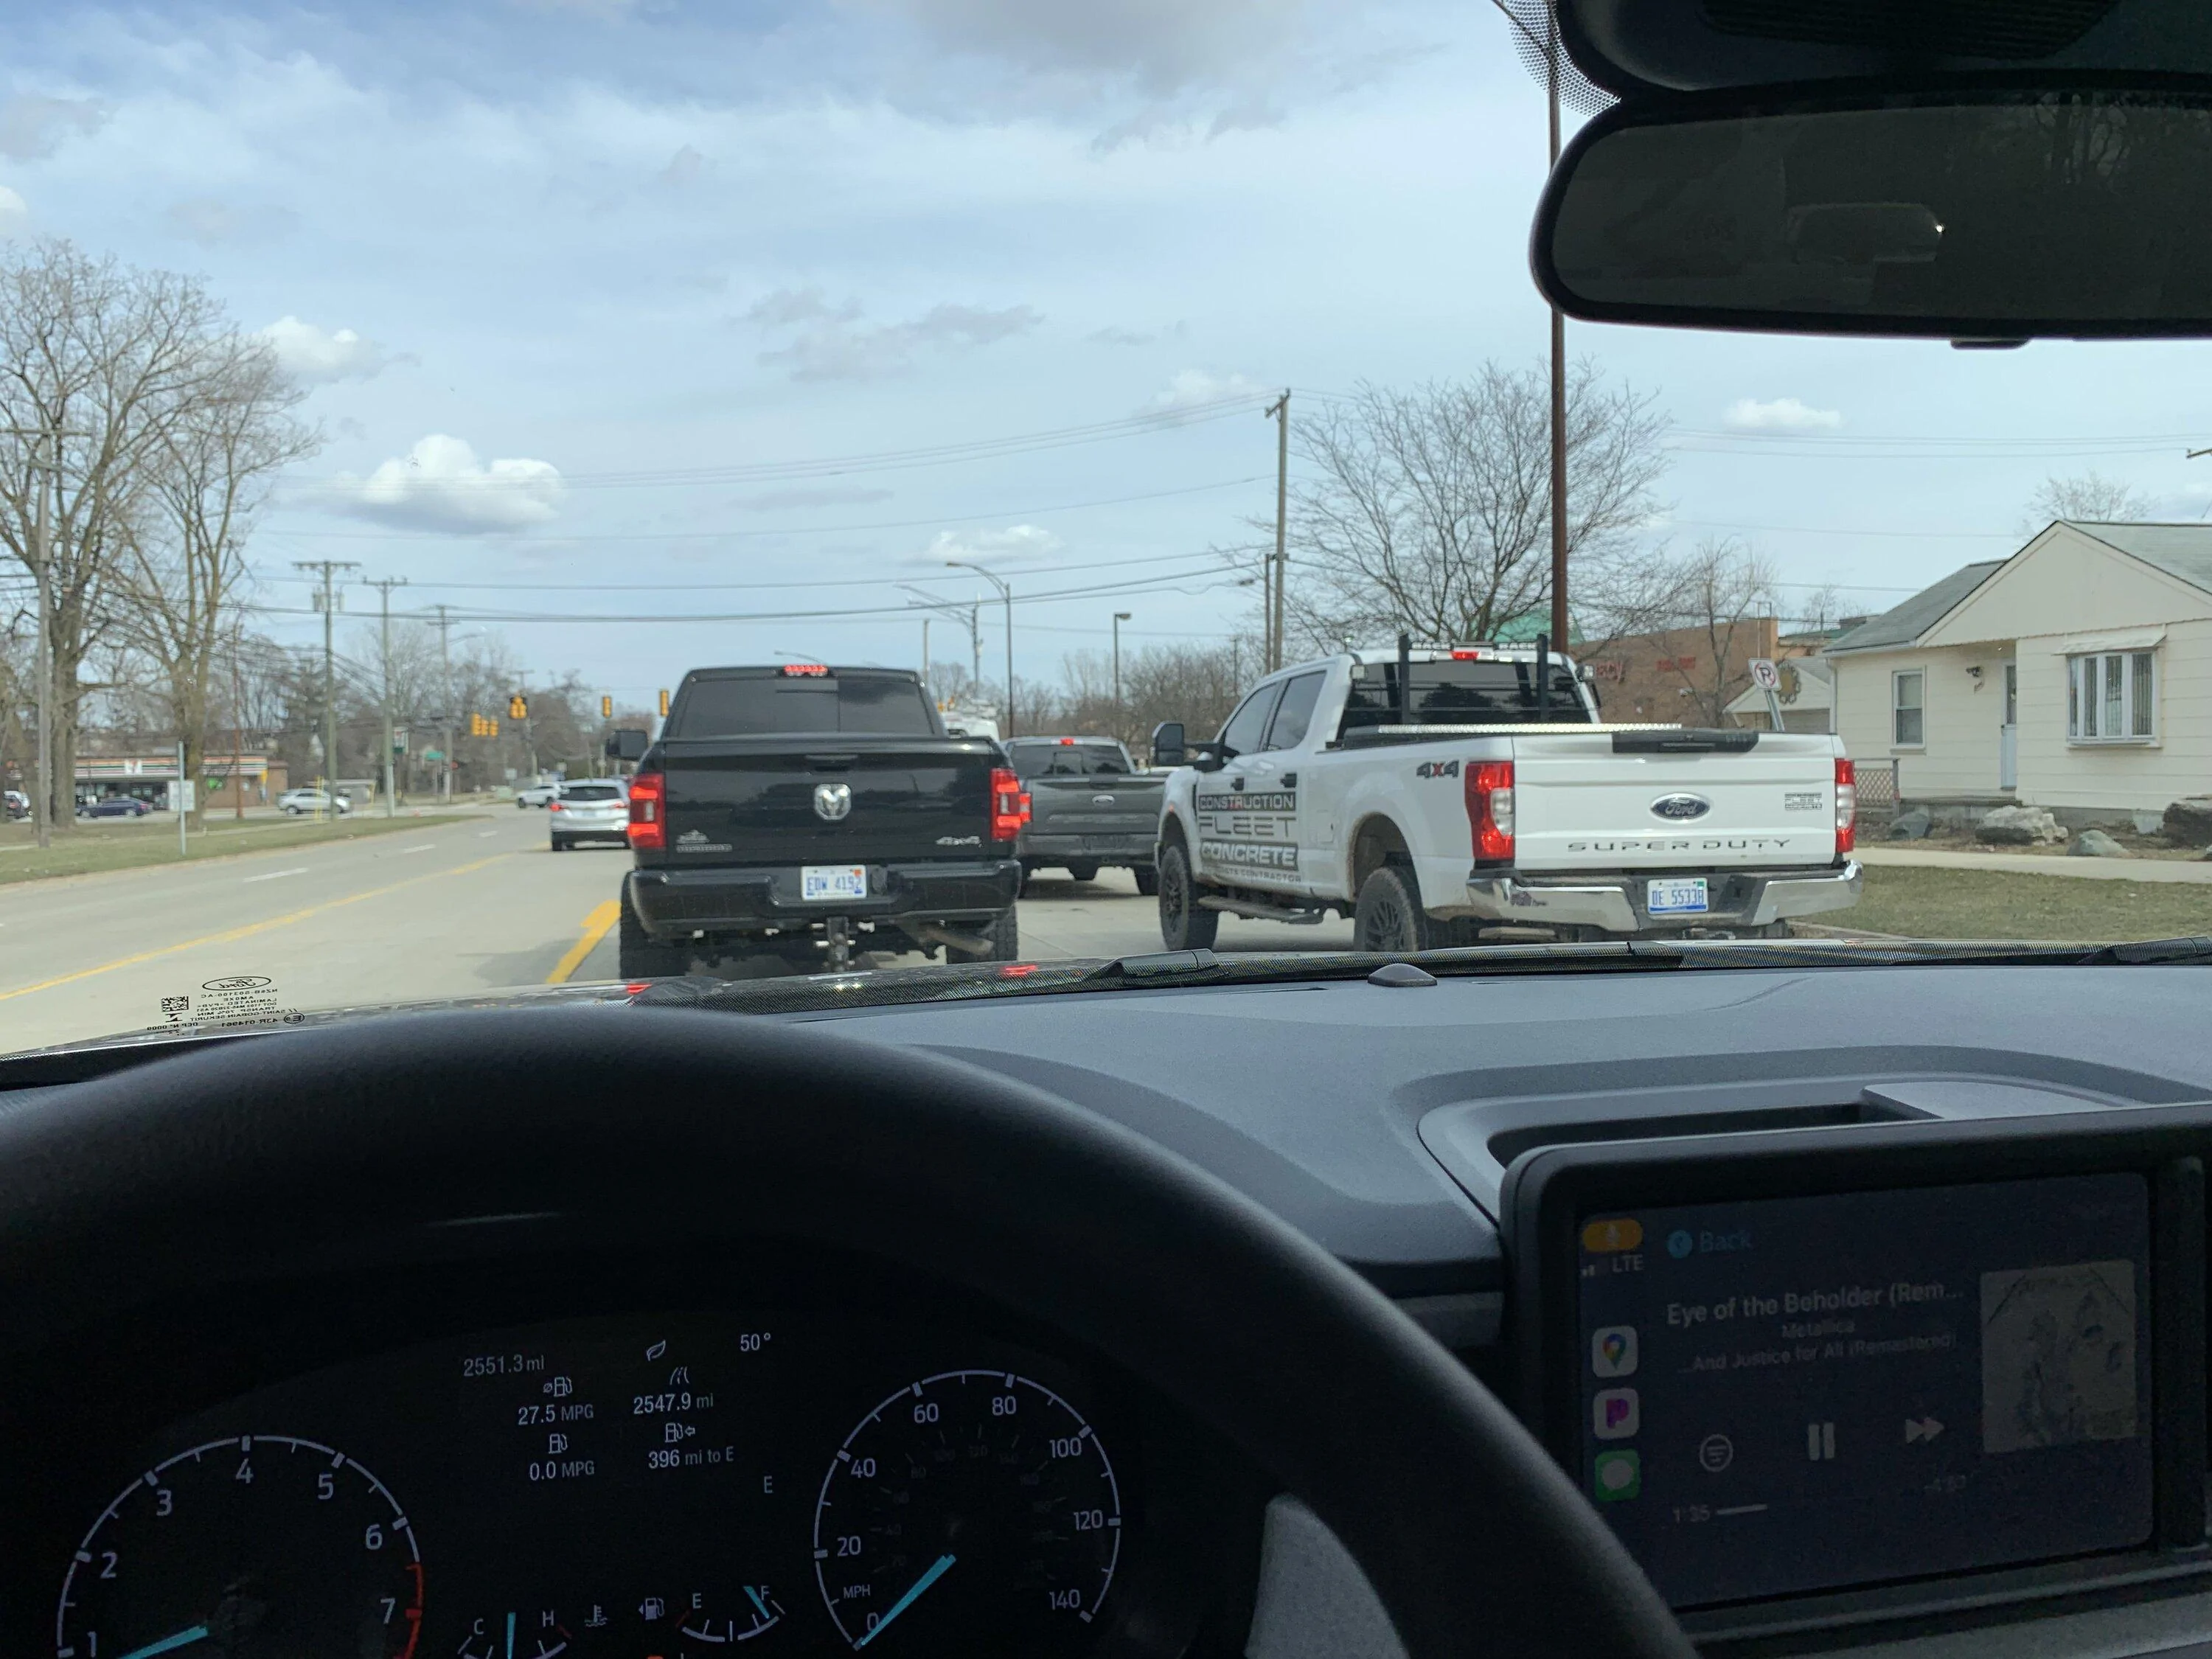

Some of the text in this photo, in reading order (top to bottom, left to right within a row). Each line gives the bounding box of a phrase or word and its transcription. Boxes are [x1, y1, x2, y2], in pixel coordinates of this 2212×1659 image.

[1199, 794, 1294, 810] CONSTRUCTION
[1198, 815, 1297, 838] FLEET
[1200, 841, 1295, 867] CONCRETE
[1568, 839, 1790, 852] SUPER DUTY
[1699, 1231, 1753, 1253] Back
[1613, 1253, 1644, 1273] LTE
[1666, 1304, 1707, 1328] Eye
[1713, 1298, 1736, 1320] of
[1743, 1295, 1778, 1317] the
[1784, 1285, 1881, 1314] Beholder
[740, 1332, 771, 1352] 50°
[518, 1403, 594, 1425] 27.5 MPG
[633, 1392, 714, 1415] 2547.9 mi
[914, 1402, 939, 1424] 60
[991, 1396, 1017, 1416] 80
[648, 1446, 734, 1470] 396 mi to E
[1048, 1436, 1082, 1458] 100
[235, 1458, 254, 1484] 4
[529, 1461, 595, 1481] 0.0 MPG
[849, 1458, 877, 1478] 40
[317, 1472, 334, 1500] 5
[764, 1476, 773, 1494] E
[156, 1489, 173, 1517] 3
[1073, 1509, 1104, 1531] 120
[365, 1523, 383, 1550] 6
[837, 1535, 862, 1557] 20
[100, 1551, 118, 1579] 2
[692, 1593, 702, 1610] E
[760, 1585, 770, 1601] F
[843, 1584, 871, 1599] MPH
[1048, 1589, 1081, 1610] 140
[380, 1597, 396, 1624] 7
[541, 1610, 554, 1627] H
[473, 1618, 484, 1635] C
[866, 1613, 880, 1631] 0
[86, 1630, 97, 1659] 1
